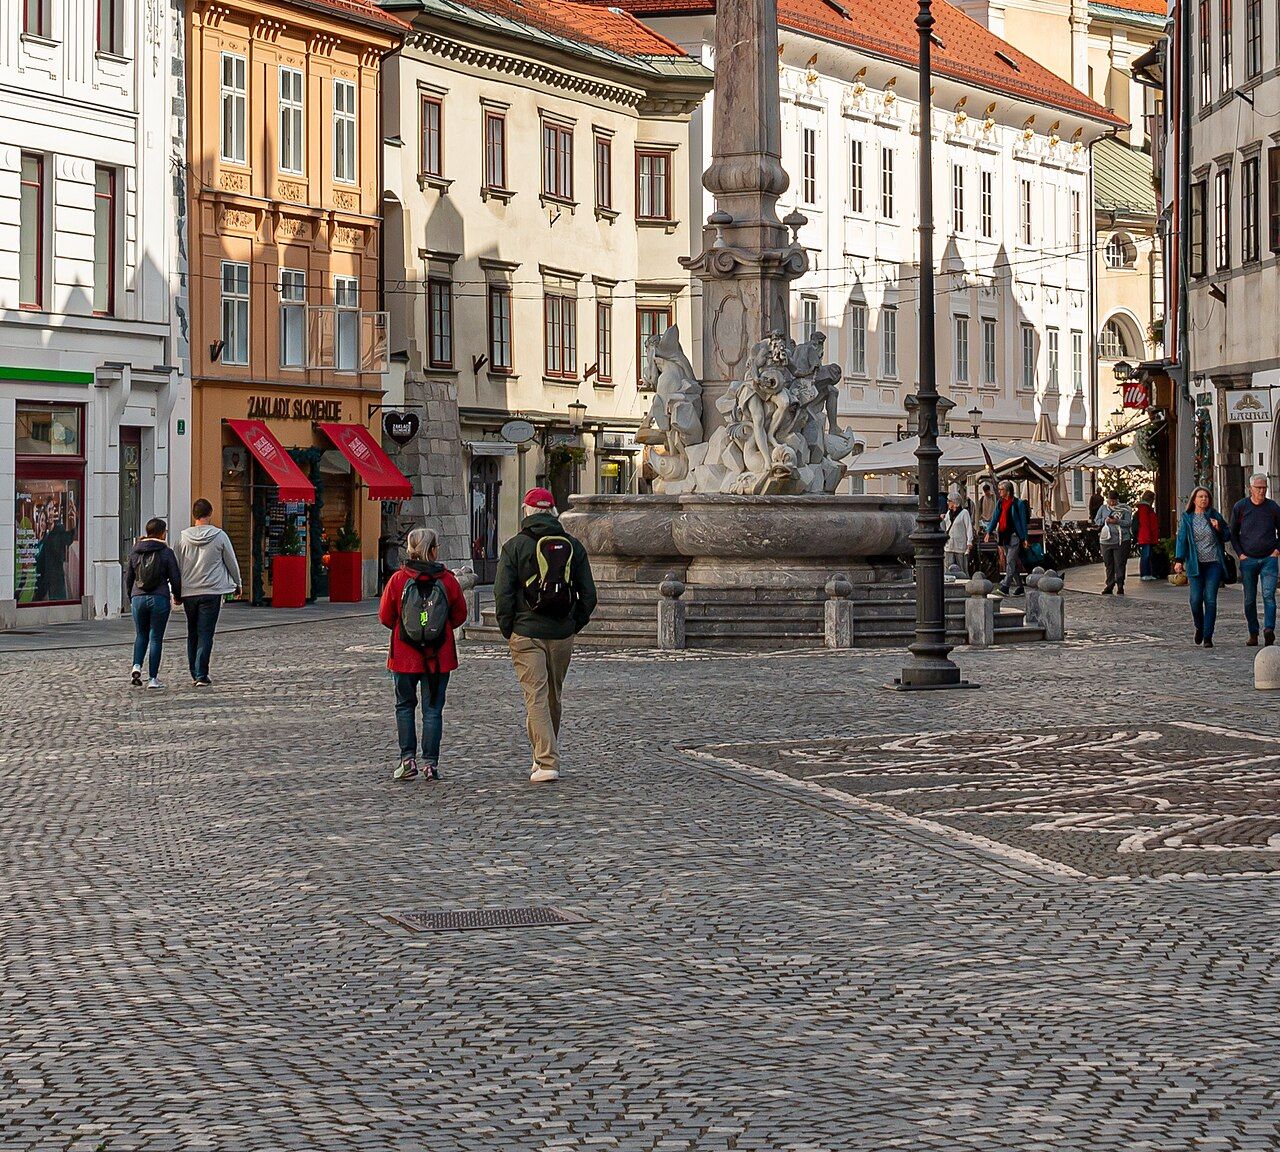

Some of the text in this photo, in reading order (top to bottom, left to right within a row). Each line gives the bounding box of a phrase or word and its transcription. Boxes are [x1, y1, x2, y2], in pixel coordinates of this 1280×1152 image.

[1124, 386, 1146, 406] illy
[248, 396, 342, 421] ZAKLADI SLOVENIJE
[1229, 411, 1269, 421] LAURA
